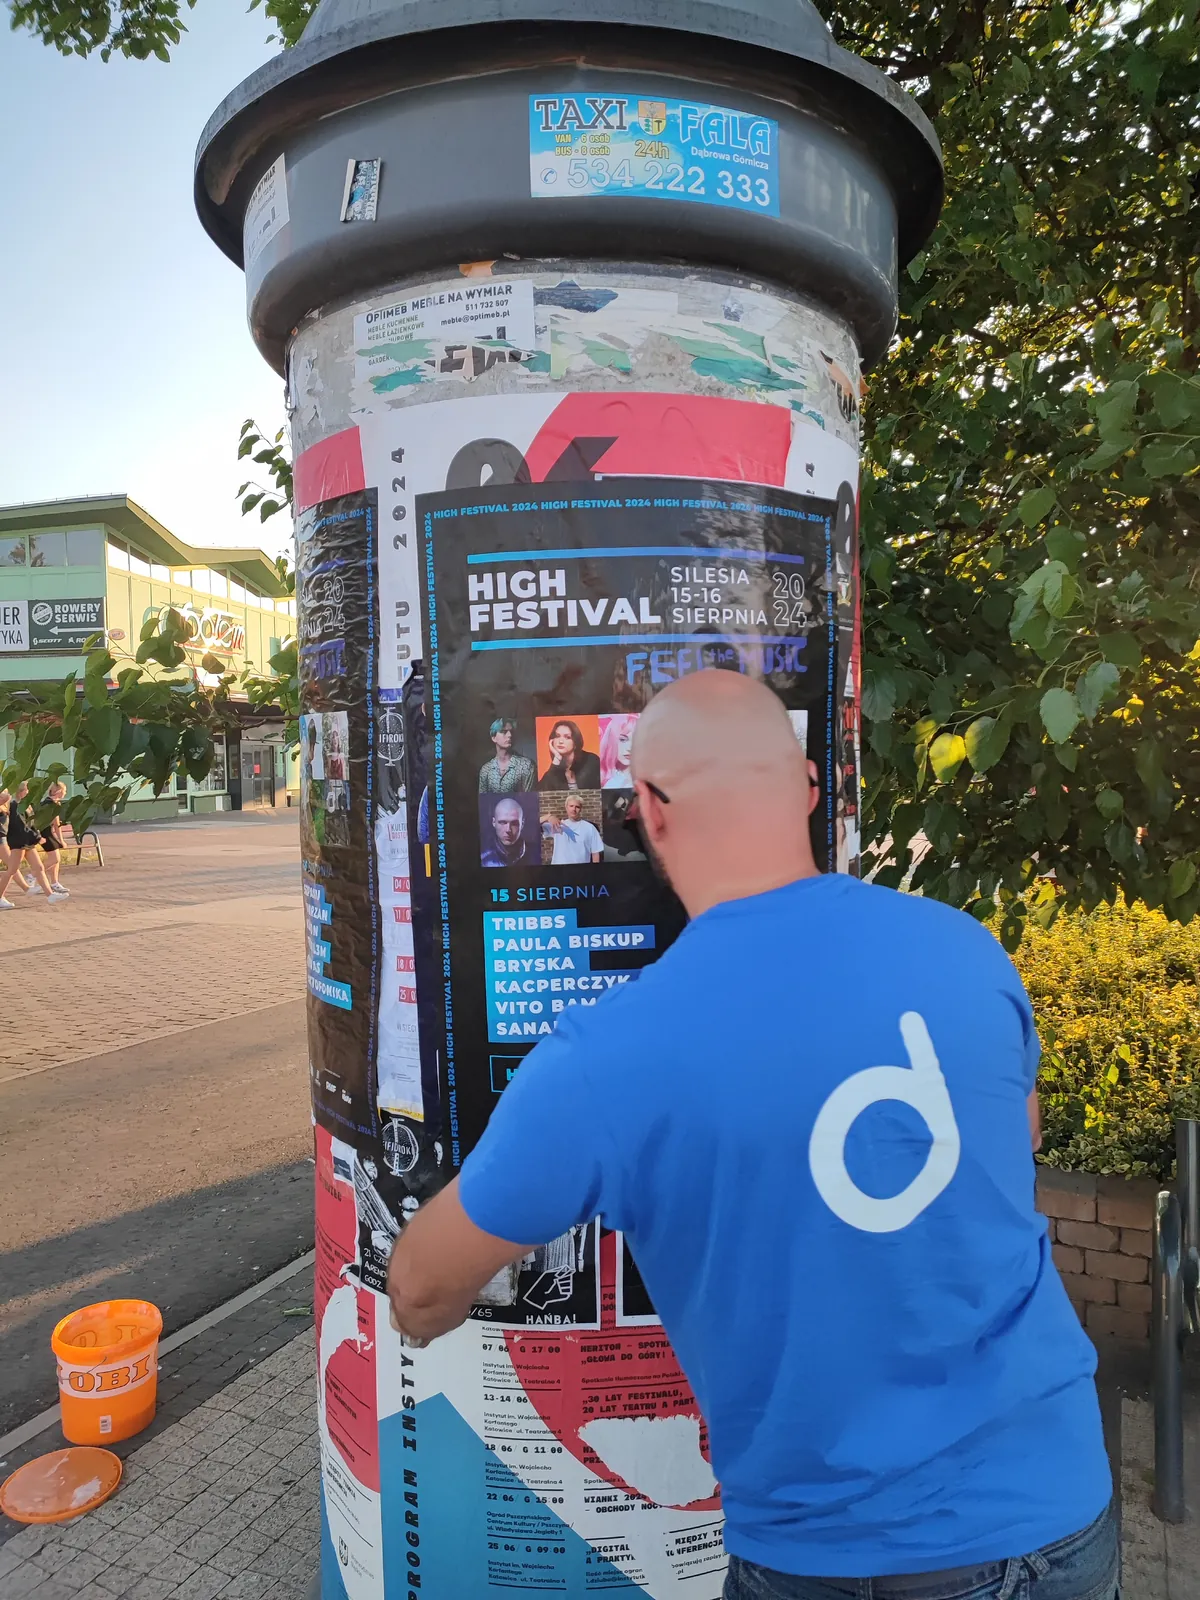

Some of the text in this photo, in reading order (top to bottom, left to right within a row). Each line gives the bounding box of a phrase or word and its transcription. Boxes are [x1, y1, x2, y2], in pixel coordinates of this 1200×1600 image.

[534, 97, 629, 132] TAXI
[679, 104, 771, 156] FALA
[555, 133, 611, 143] VAN 6 osób
[555, 145, 611, 156] BUS 8 osób
[635, 139, 670, 159] 24h
[691, 146, 770, 170] Dąbrowa Górnicza
[567, 158, 771, 207] 534 222 333
[365, 304, 408, 324] OPTIMEB
[448, 292, 463, 304] NA
[465, 284, 513, 300] WYMIAR
[480, 301, 494, 310] 732
[386, 314, 419, 329] KUCHENNE
[440, 310, 510, 326] meble@optimeb.pl
[434, 509, 458, 519] HIGH
[461, 503, 509, 516] FESTIVAL
[512, 502, 538, 512] 2024
[541, 500, 568, 510] HIGH
[571, 499, 622, 509] FESTIVAL
[625, 498, 651, 508] 2024
[653, 498, 679, 508] HIGH
[682, 499, 728, 510] FESTIVAL
[671, 567, 750, 585] SILESIA
[468, 569, 566, 602] HIGH
[772, 572, 805, 600] 20
[671, 587, 722, 604] 15-16
[54, 603, 101, 614] ROWERY
[469, 597, 661, 631] FESTIVAL
[773, 600, 809, 628] 24
[54, 613, 97, 624] SERWIS
[672, 606, 768, 626] SIERPNIA
[424, 512, 461, 1167] HIGH FESTIVAL 2024 HIGH FESTIVAL 2024 HIGH FESTIVAL 2024 HIGH FESTIVAL 2024 HIGH FESTIVAL 2024 HIGH FESTIVAL 2024
[490, 885, 610, 902] 15 SIERPNIA
[491, 915, 566, 931] TRIBBS
[493, 932, 645, 952] PAULA BISKUP
[493, 957, 575, 973] BRYSKA
[495, 1000, 544, 1015] VITO
[526, 1312, 577, 1325] HAŃBA!
[621, 1353, 633, 1361] DO
[638, 1350, 666, 1360] GÓRY!
[482, 1361, 505, 1369] Instytut
[68, 1353, 151, 1393] OBI
[482, 1369, 517, 1377] Korfantego
[605, 1389, 683, 1402] LAT FESTIWALU,
[483, 1411, 507, 1419] Instytut
[582, 1406, 595, 1414] 20
[600, 1404, 617, 1413] LAT
[484, 1419, 518, 1427] Korfantego
[485, 1468, 519, 1476] Korfantego
[485, 1475, 514, 1483] Katowice
[583, 1494, 618, 1504] WIANKI
[486, 1510, 506, 1518] Ogród
[596, 1504, 636, 1514] OBCHODY
[486, 1518, 513, 1526] Centrum
[675, 1532, 708, 1545] MIĘDZY
[487, 1559, 511, 1567] Instytut
[586, 1556, 592, 1564] A
[488, 1573, 518, 1581] Katowice
